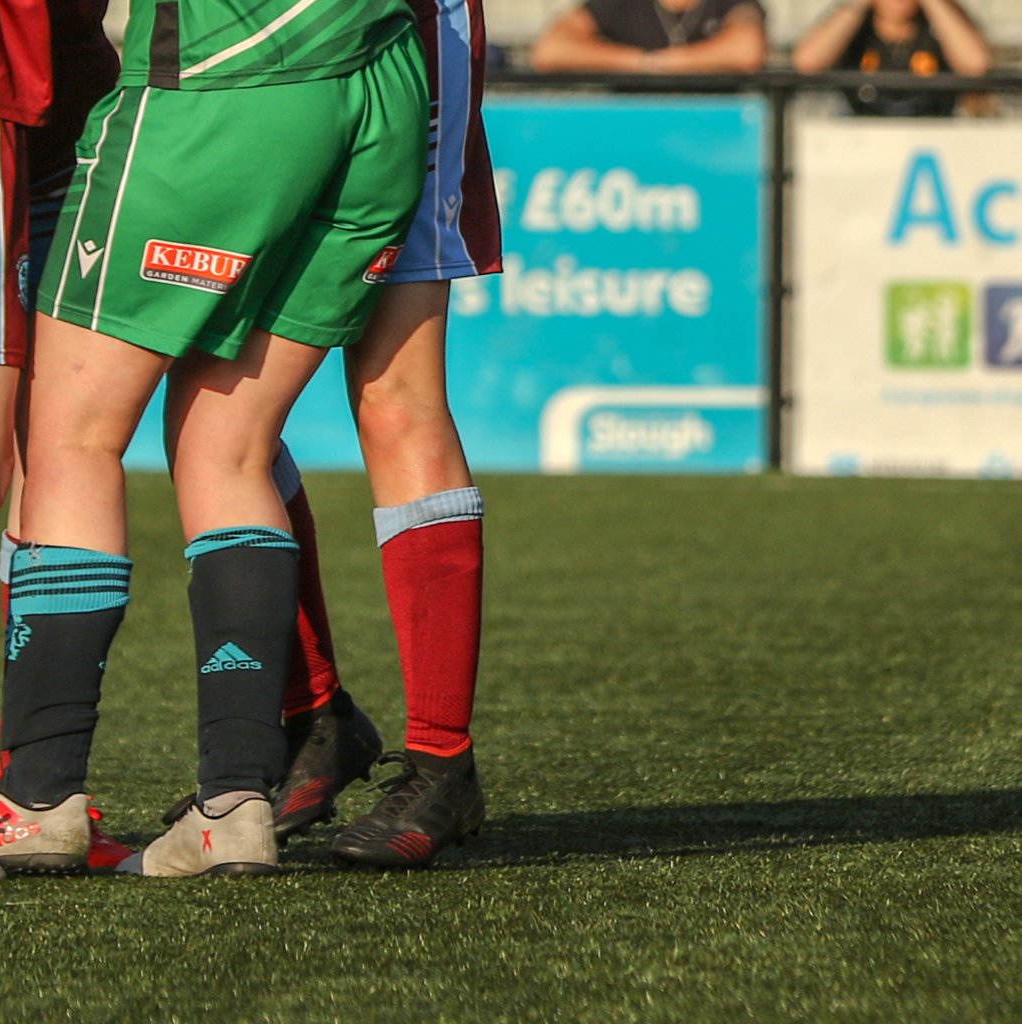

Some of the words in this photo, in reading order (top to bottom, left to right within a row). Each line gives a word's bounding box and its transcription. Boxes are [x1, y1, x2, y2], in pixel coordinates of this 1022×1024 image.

[522, 167, 701, 233] £60m
[146, 270, 189, 283] GARDEN
[501, 252, 711, 317] leisure
[200, 658, 262, 674] adidas
